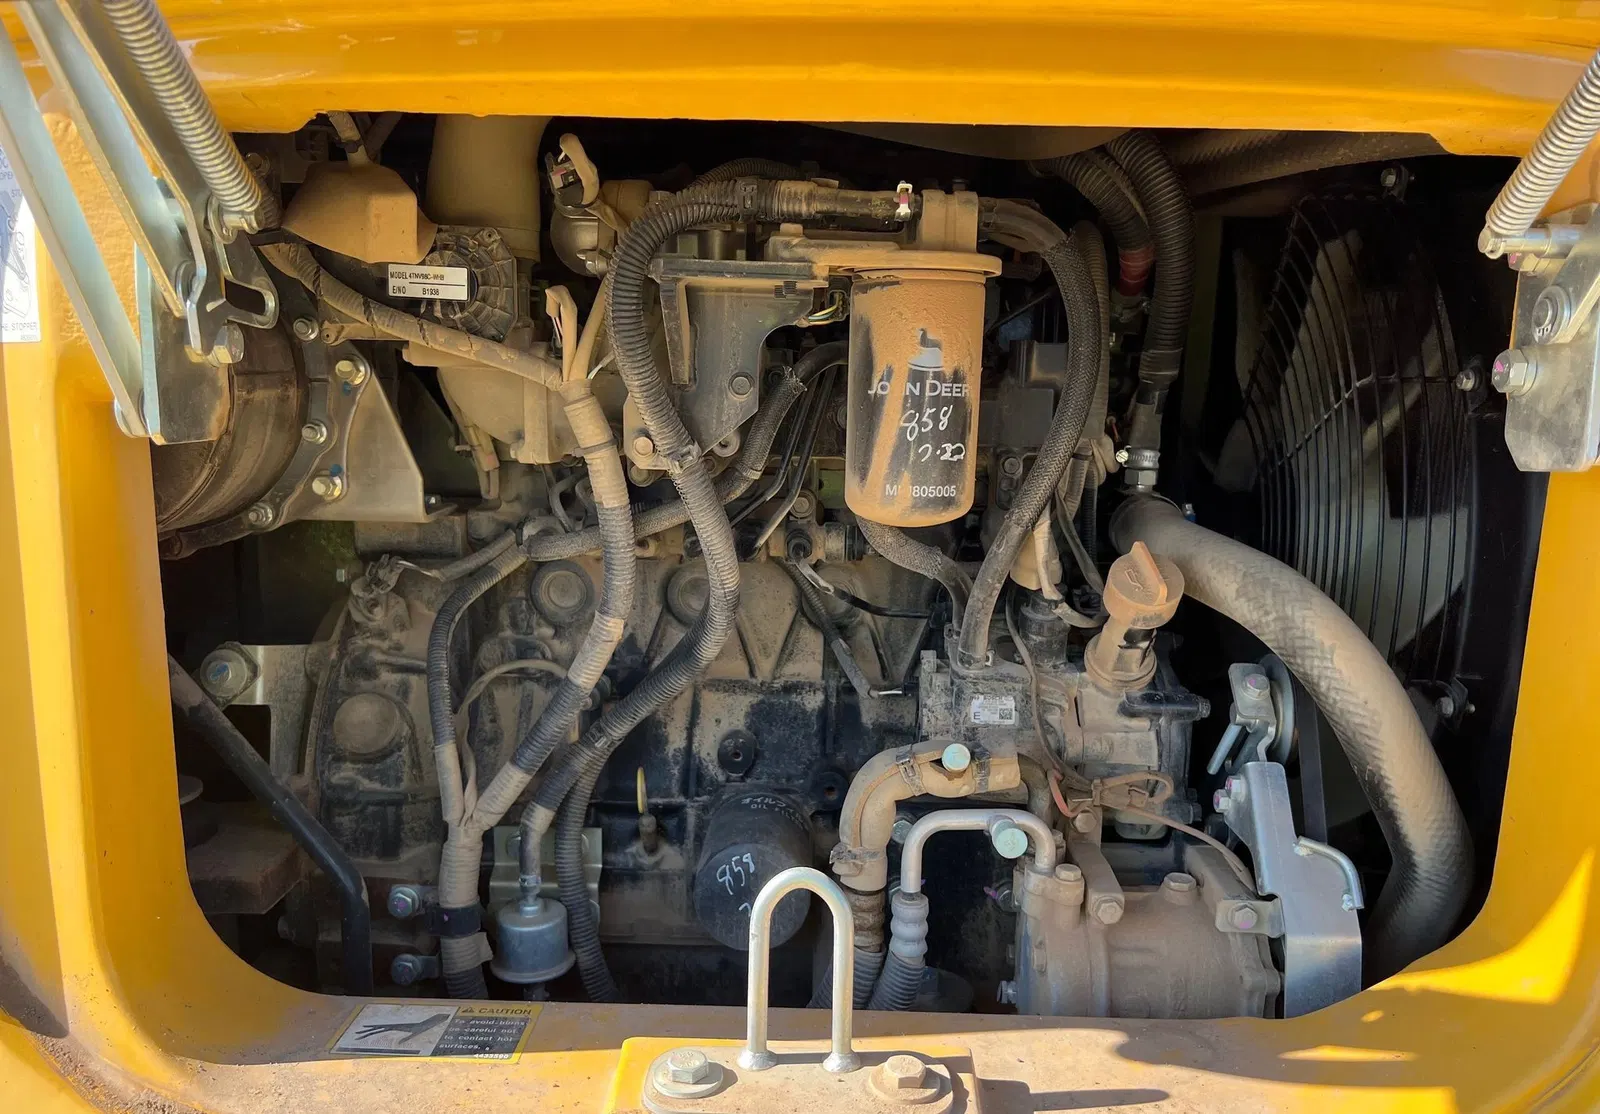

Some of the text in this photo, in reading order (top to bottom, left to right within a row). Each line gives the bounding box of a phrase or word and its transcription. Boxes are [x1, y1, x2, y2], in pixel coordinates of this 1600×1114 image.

[390, 272, 408, 280] MODEL
[392, 286, 407, 294] E/NO
[868, 381, 920, 396] JON
[900, 404, 954, 442] 858
[885, 485, 957, 498] M805005
[973, 711, 981, 720] E
[716, 852, 756, 896] 858
[478, 1006, 532, 1015] CAUTION
